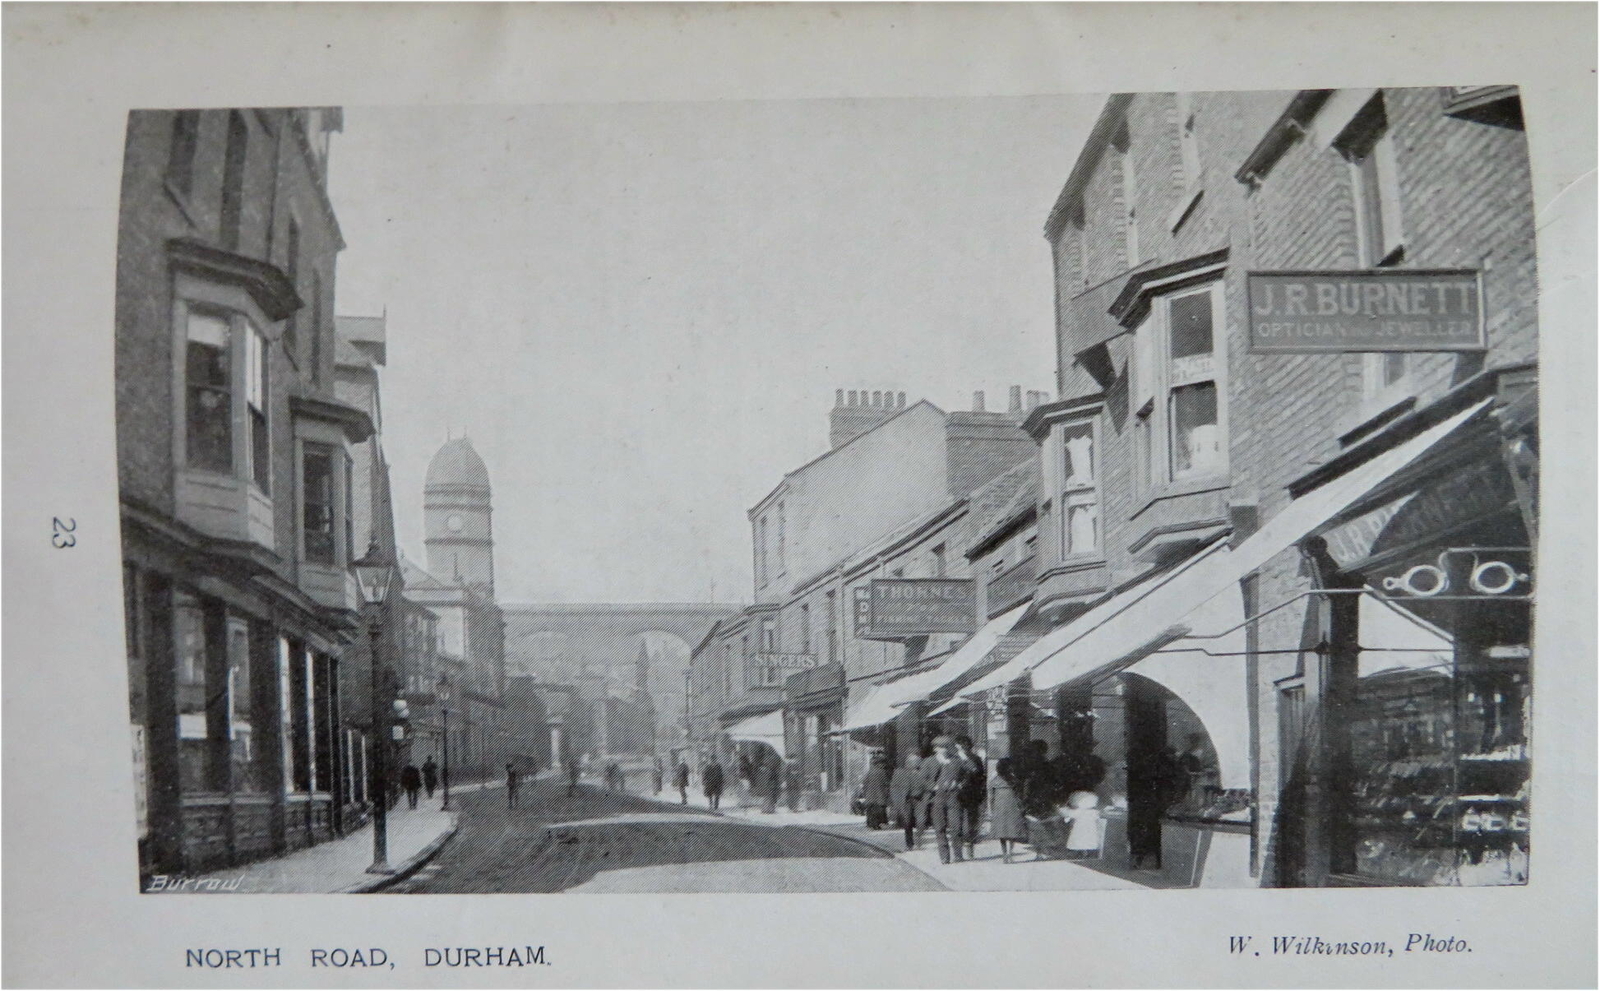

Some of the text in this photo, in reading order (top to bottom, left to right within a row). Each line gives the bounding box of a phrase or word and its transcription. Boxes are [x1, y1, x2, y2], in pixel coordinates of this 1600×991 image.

[1257, 322, 1348, 338] OPTICIAN
[51, 516, 77, 550] 23
[876, 585, 967, 600] THORNES
[926, 614, 968, 625] TACKLE
[754, 653, 816, 668] SINGERS
[1229, 933, 1473, 958] W. Wilkinson, Photo.
[185, 945, 552, 971] NORTH ROAD, DURHAM.
